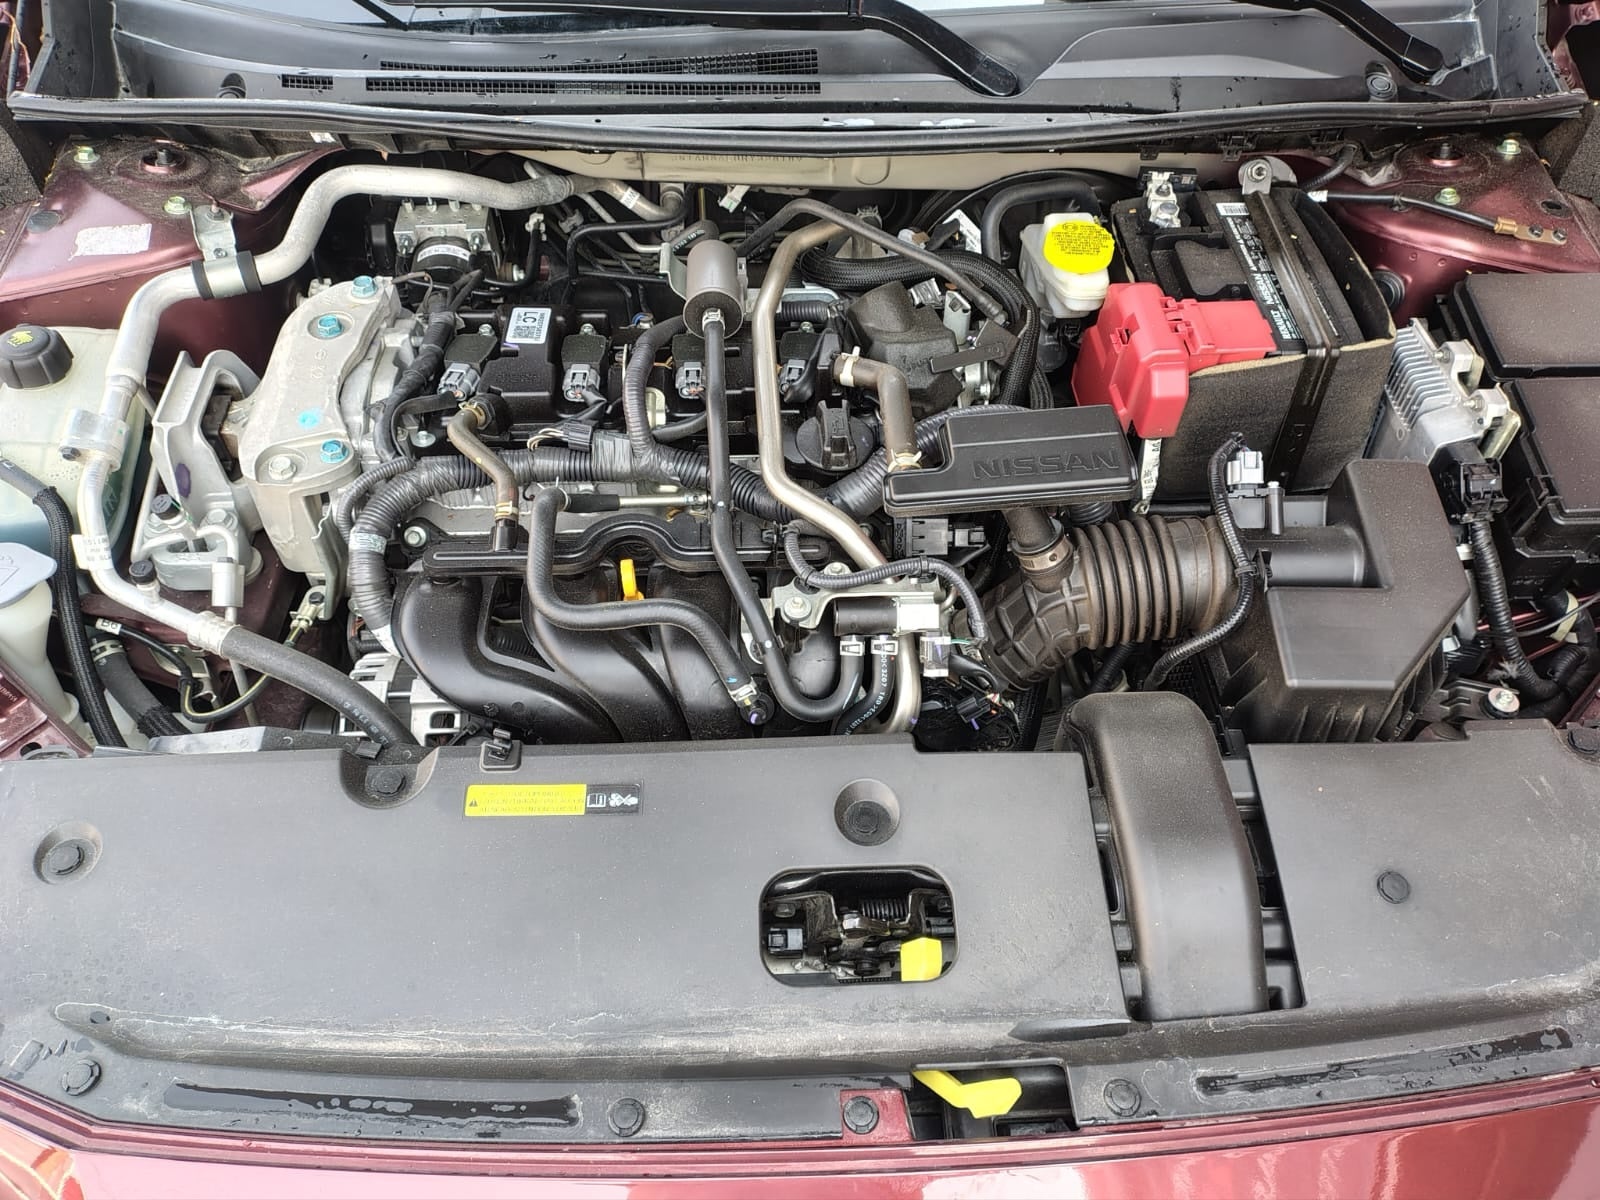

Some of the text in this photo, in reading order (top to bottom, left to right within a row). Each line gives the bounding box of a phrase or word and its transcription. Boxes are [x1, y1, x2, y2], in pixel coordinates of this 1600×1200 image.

[1252, 273, 1275, 305] NISSAN
[522, 311, 538, 324] LC
[1270, 309, 1292, 340] RENAULT
[973, 450, 1120, 480] NISSAN
